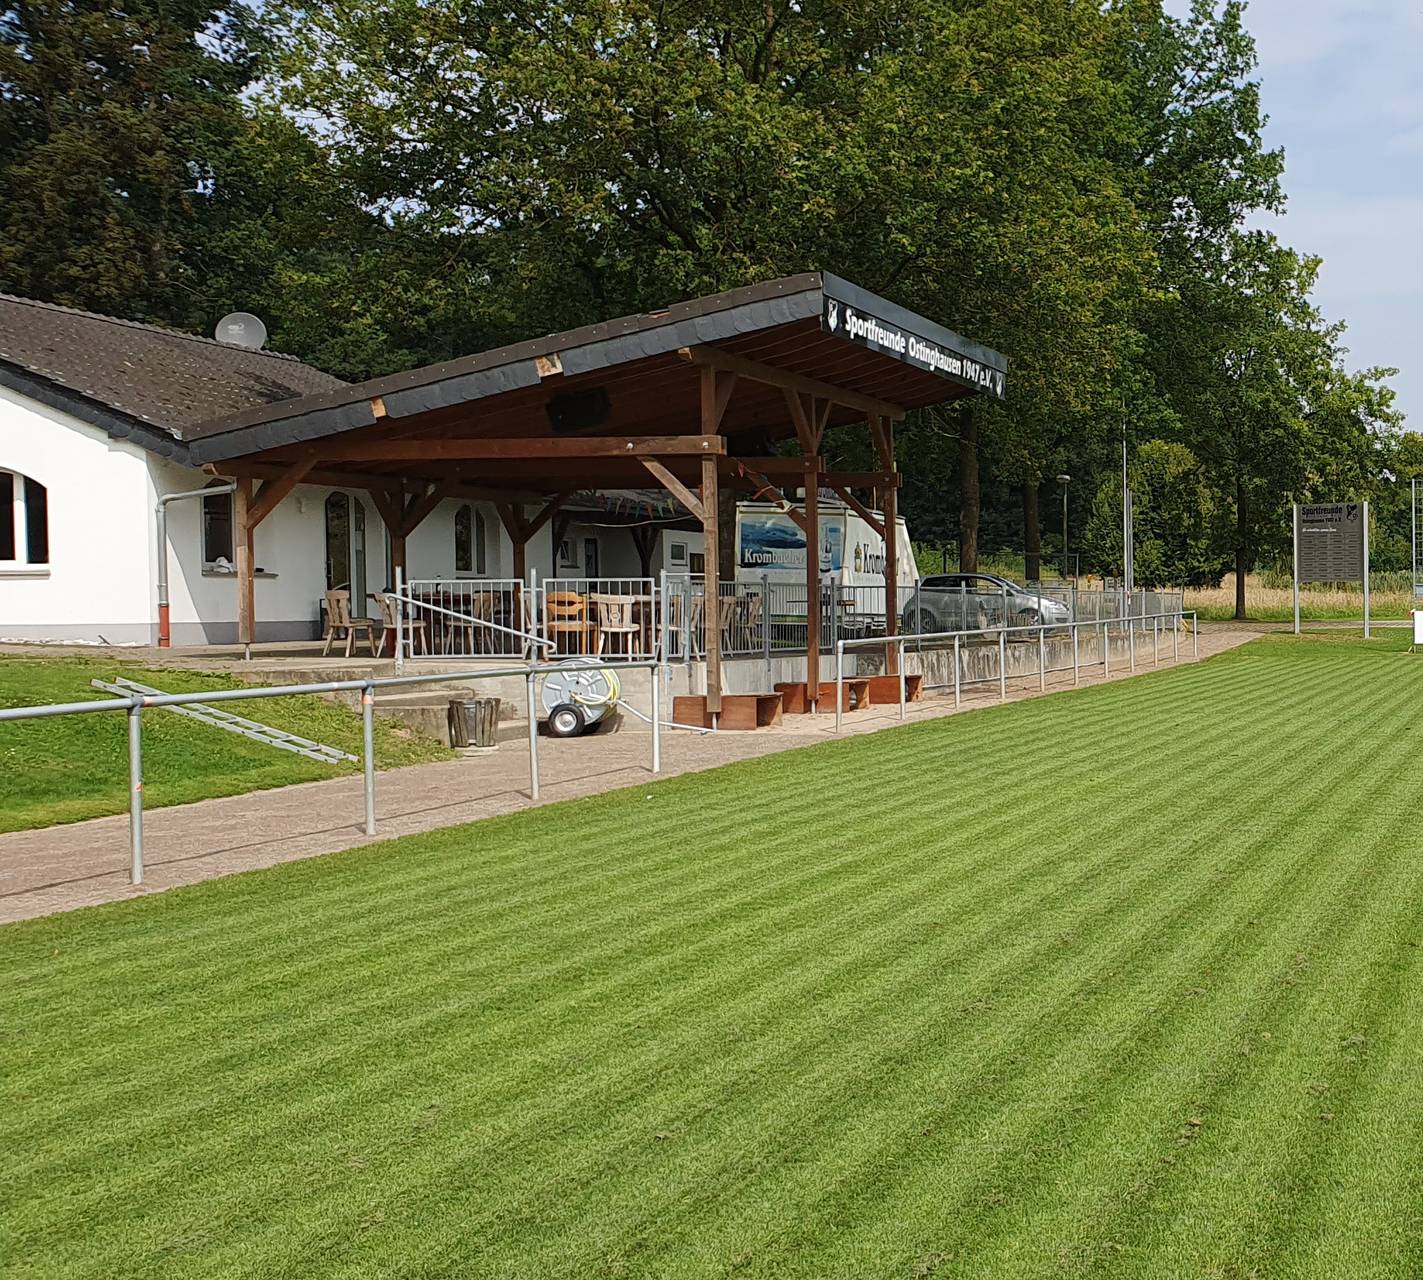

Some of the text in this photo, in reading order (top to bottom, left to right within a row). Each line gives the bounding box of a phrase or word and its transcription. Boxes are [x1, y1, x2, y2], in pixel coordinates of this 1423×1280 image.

[845, 309, 993, 389] Sportfreunde Ostinghausen 1947 e.V.
[1302, 505, 1343, 517] Sportfreunde
